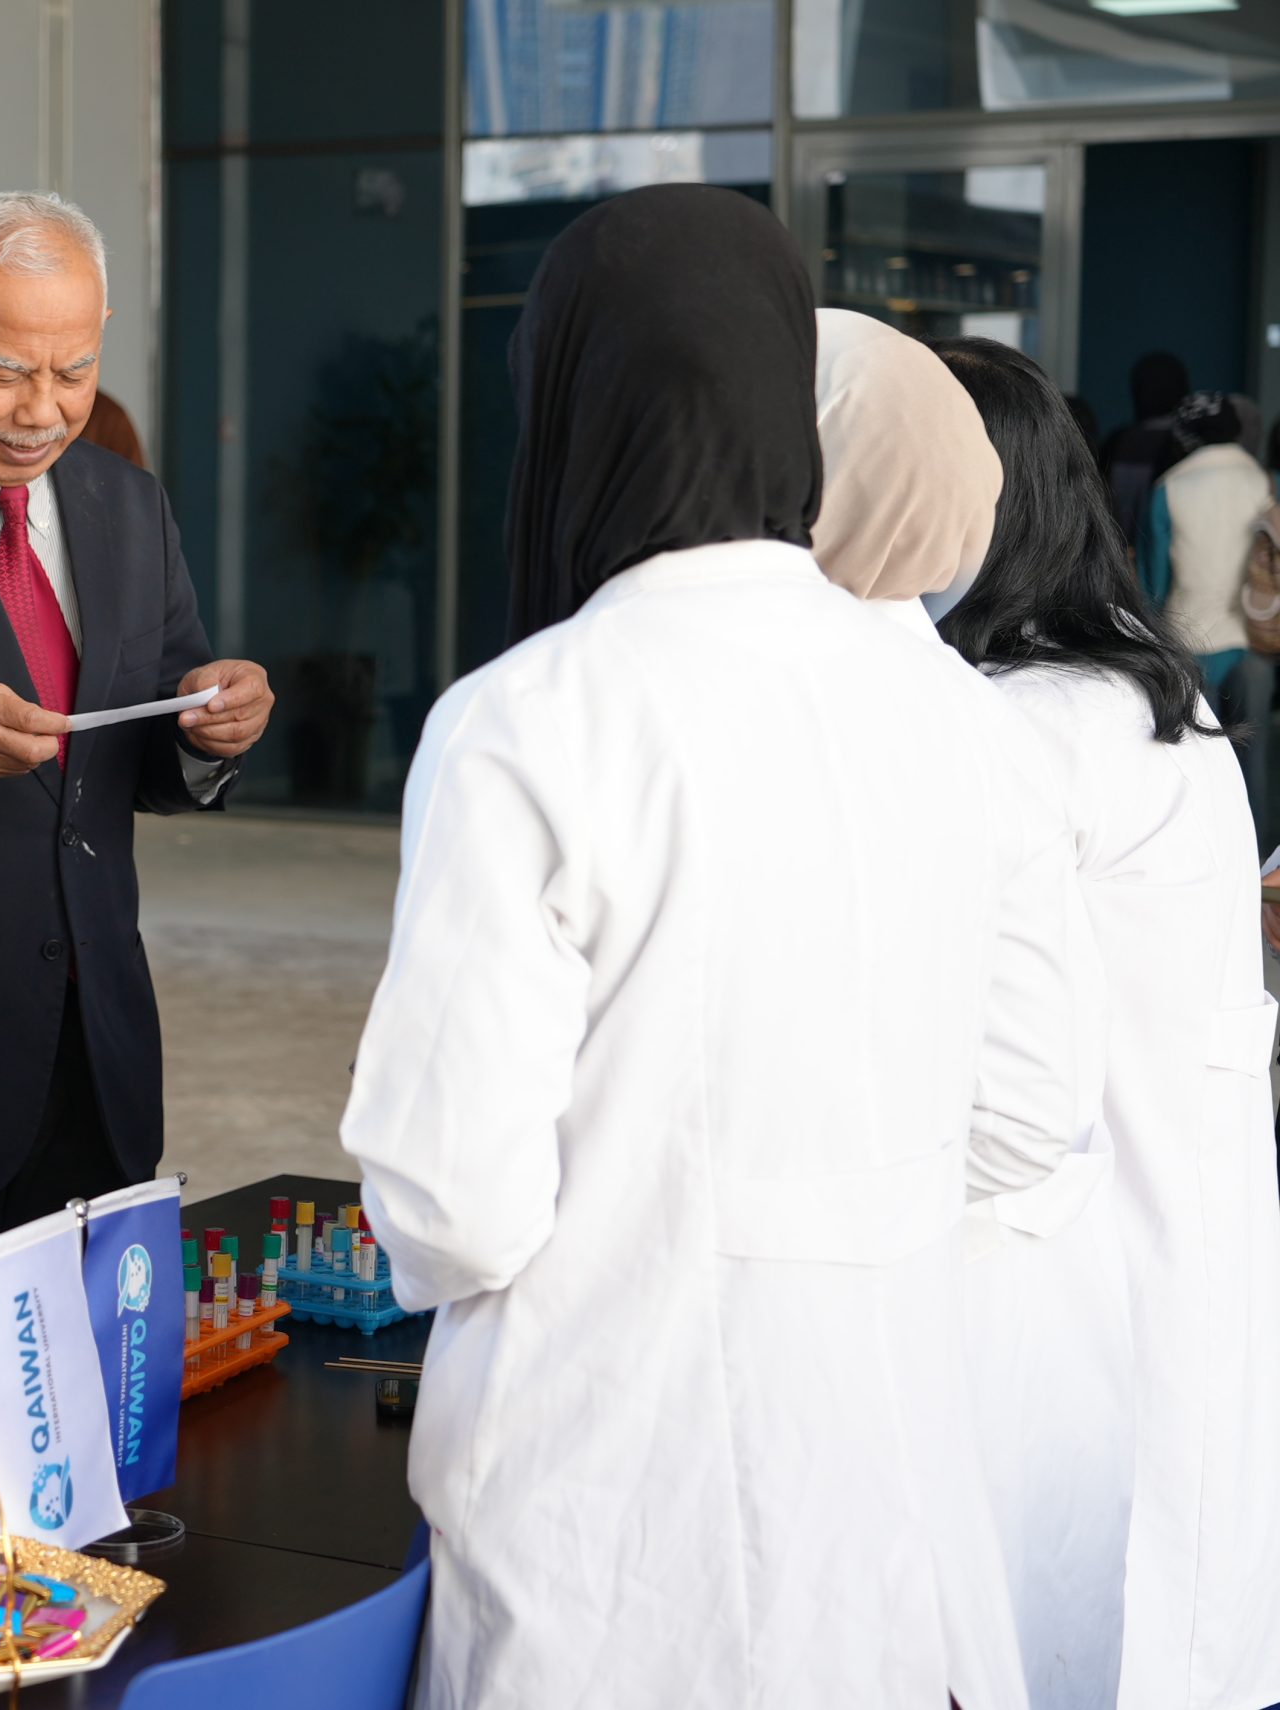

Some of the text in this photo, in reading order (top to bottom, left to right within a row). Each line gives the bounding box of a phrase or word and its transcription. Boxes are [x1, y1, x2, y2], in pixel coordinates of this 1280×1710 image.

[14, 1290, 50, 1454] QAIWAN
[33, 1287, 61, 1443] INTERNATIONAL UNIVERSITY
[117, 1323, 128, 1468] INTERNATIONAL UNIVERSITY
[125, 1318, 147, 1466] QAIWAN
